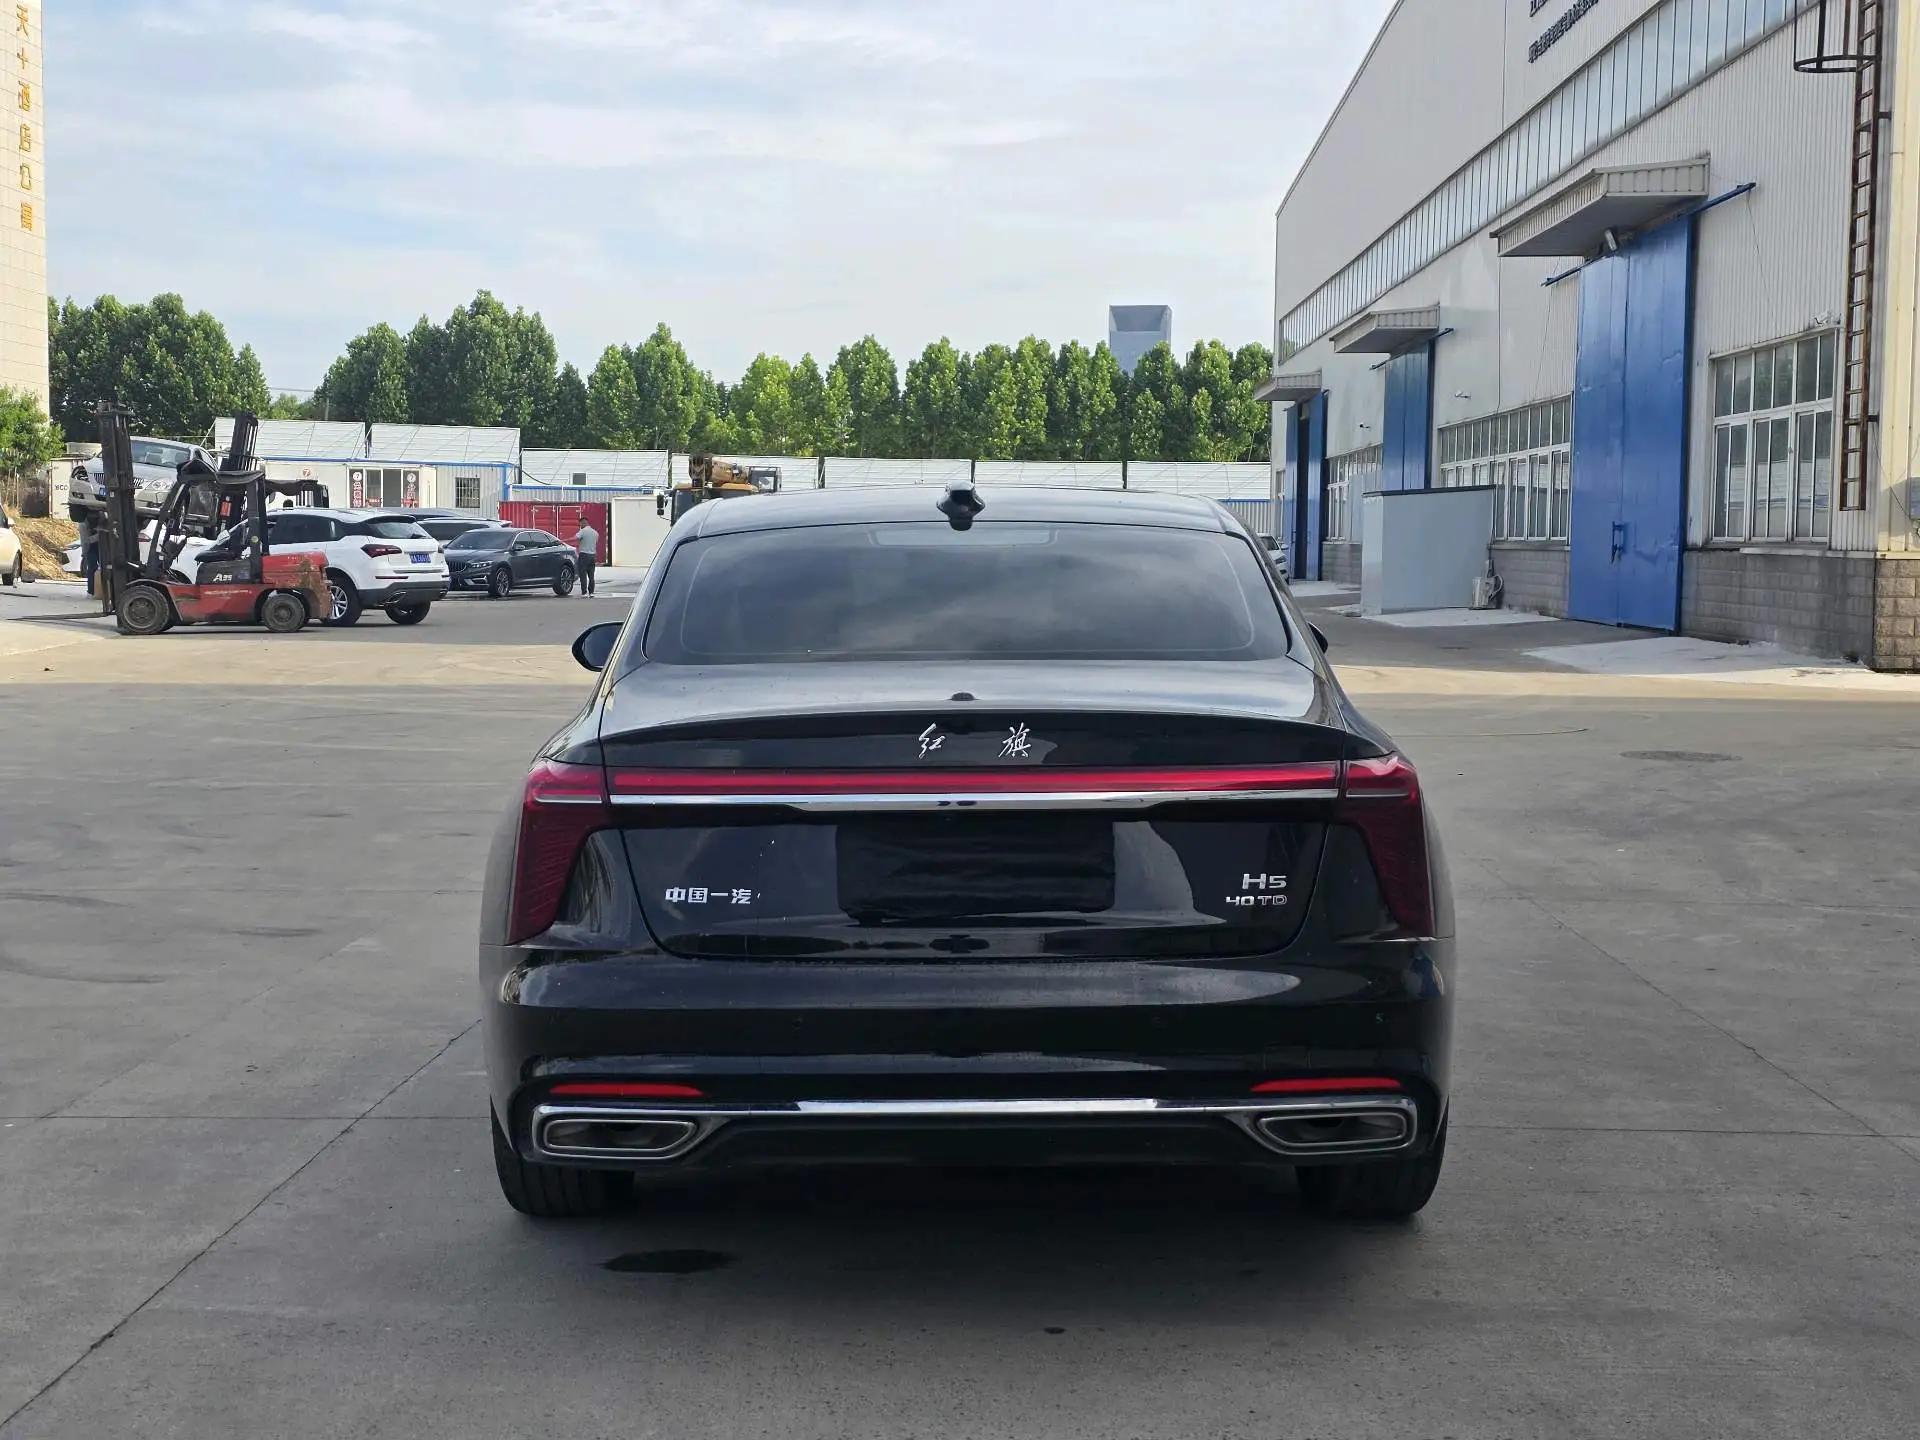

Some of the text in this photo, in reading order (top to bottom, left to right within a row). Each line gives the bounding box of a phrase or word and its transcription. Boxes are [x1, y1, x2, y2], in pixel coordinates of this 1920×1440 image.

[918, 722, 1032, 759] 红旗
[1242, 873, 1287, 890] H5
[664, 886, 752, 904] 中国一汽
